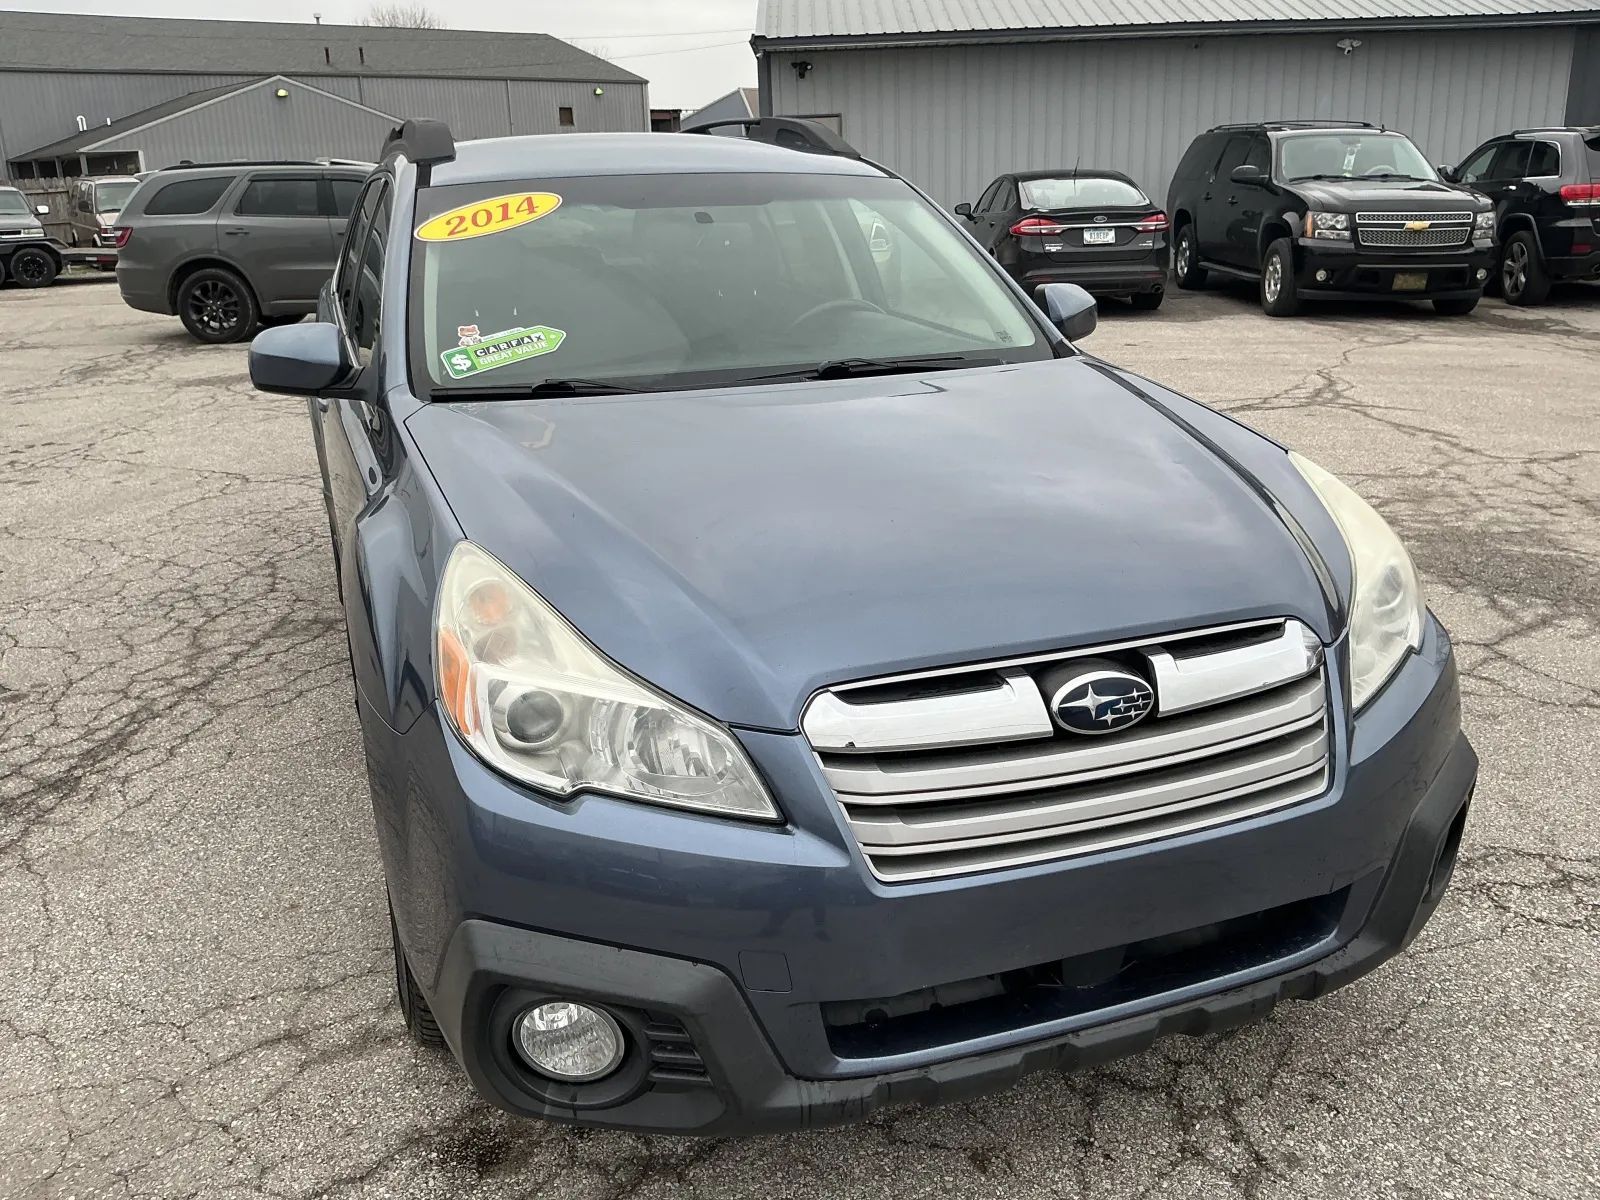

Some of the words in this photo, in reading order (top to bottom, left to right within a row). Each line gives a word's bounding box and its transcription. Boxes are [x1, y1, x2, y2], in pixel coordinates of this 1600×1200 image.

[445, 196, 539, 237] 2014
[475, 333, 545, 357] CARFAX
[479, 349, 514, 365] GREAT
[514, 341, 548, 355] VALUE
